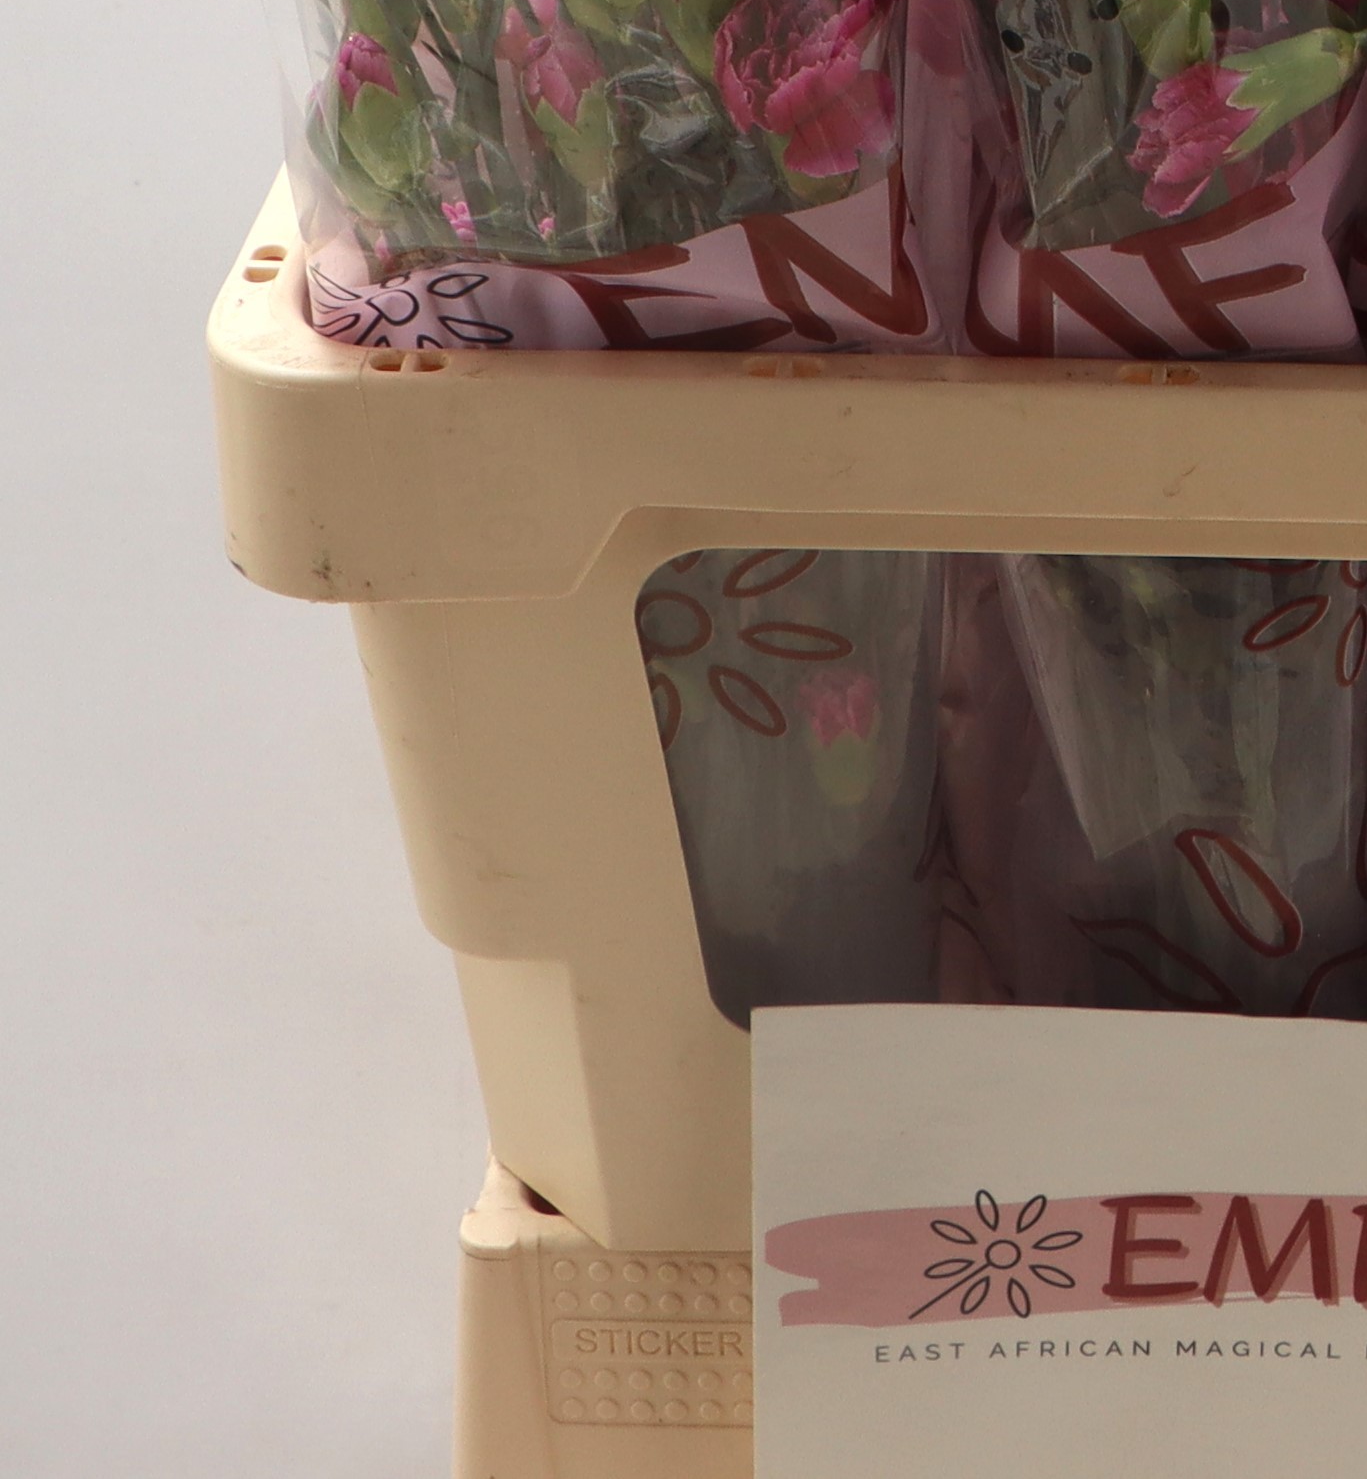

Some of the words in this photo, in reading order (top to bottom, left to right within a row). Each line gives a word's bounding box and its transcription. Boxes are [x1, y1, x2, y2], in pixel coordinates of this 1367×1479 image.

[575, 1328, 744, 1357] STICKER
[875, 1342, 965, 1363] EAST
[989, 1340, 1161, 1358] AFRICAN
[1176, 1340, 1341, 1359] MAGICAL
